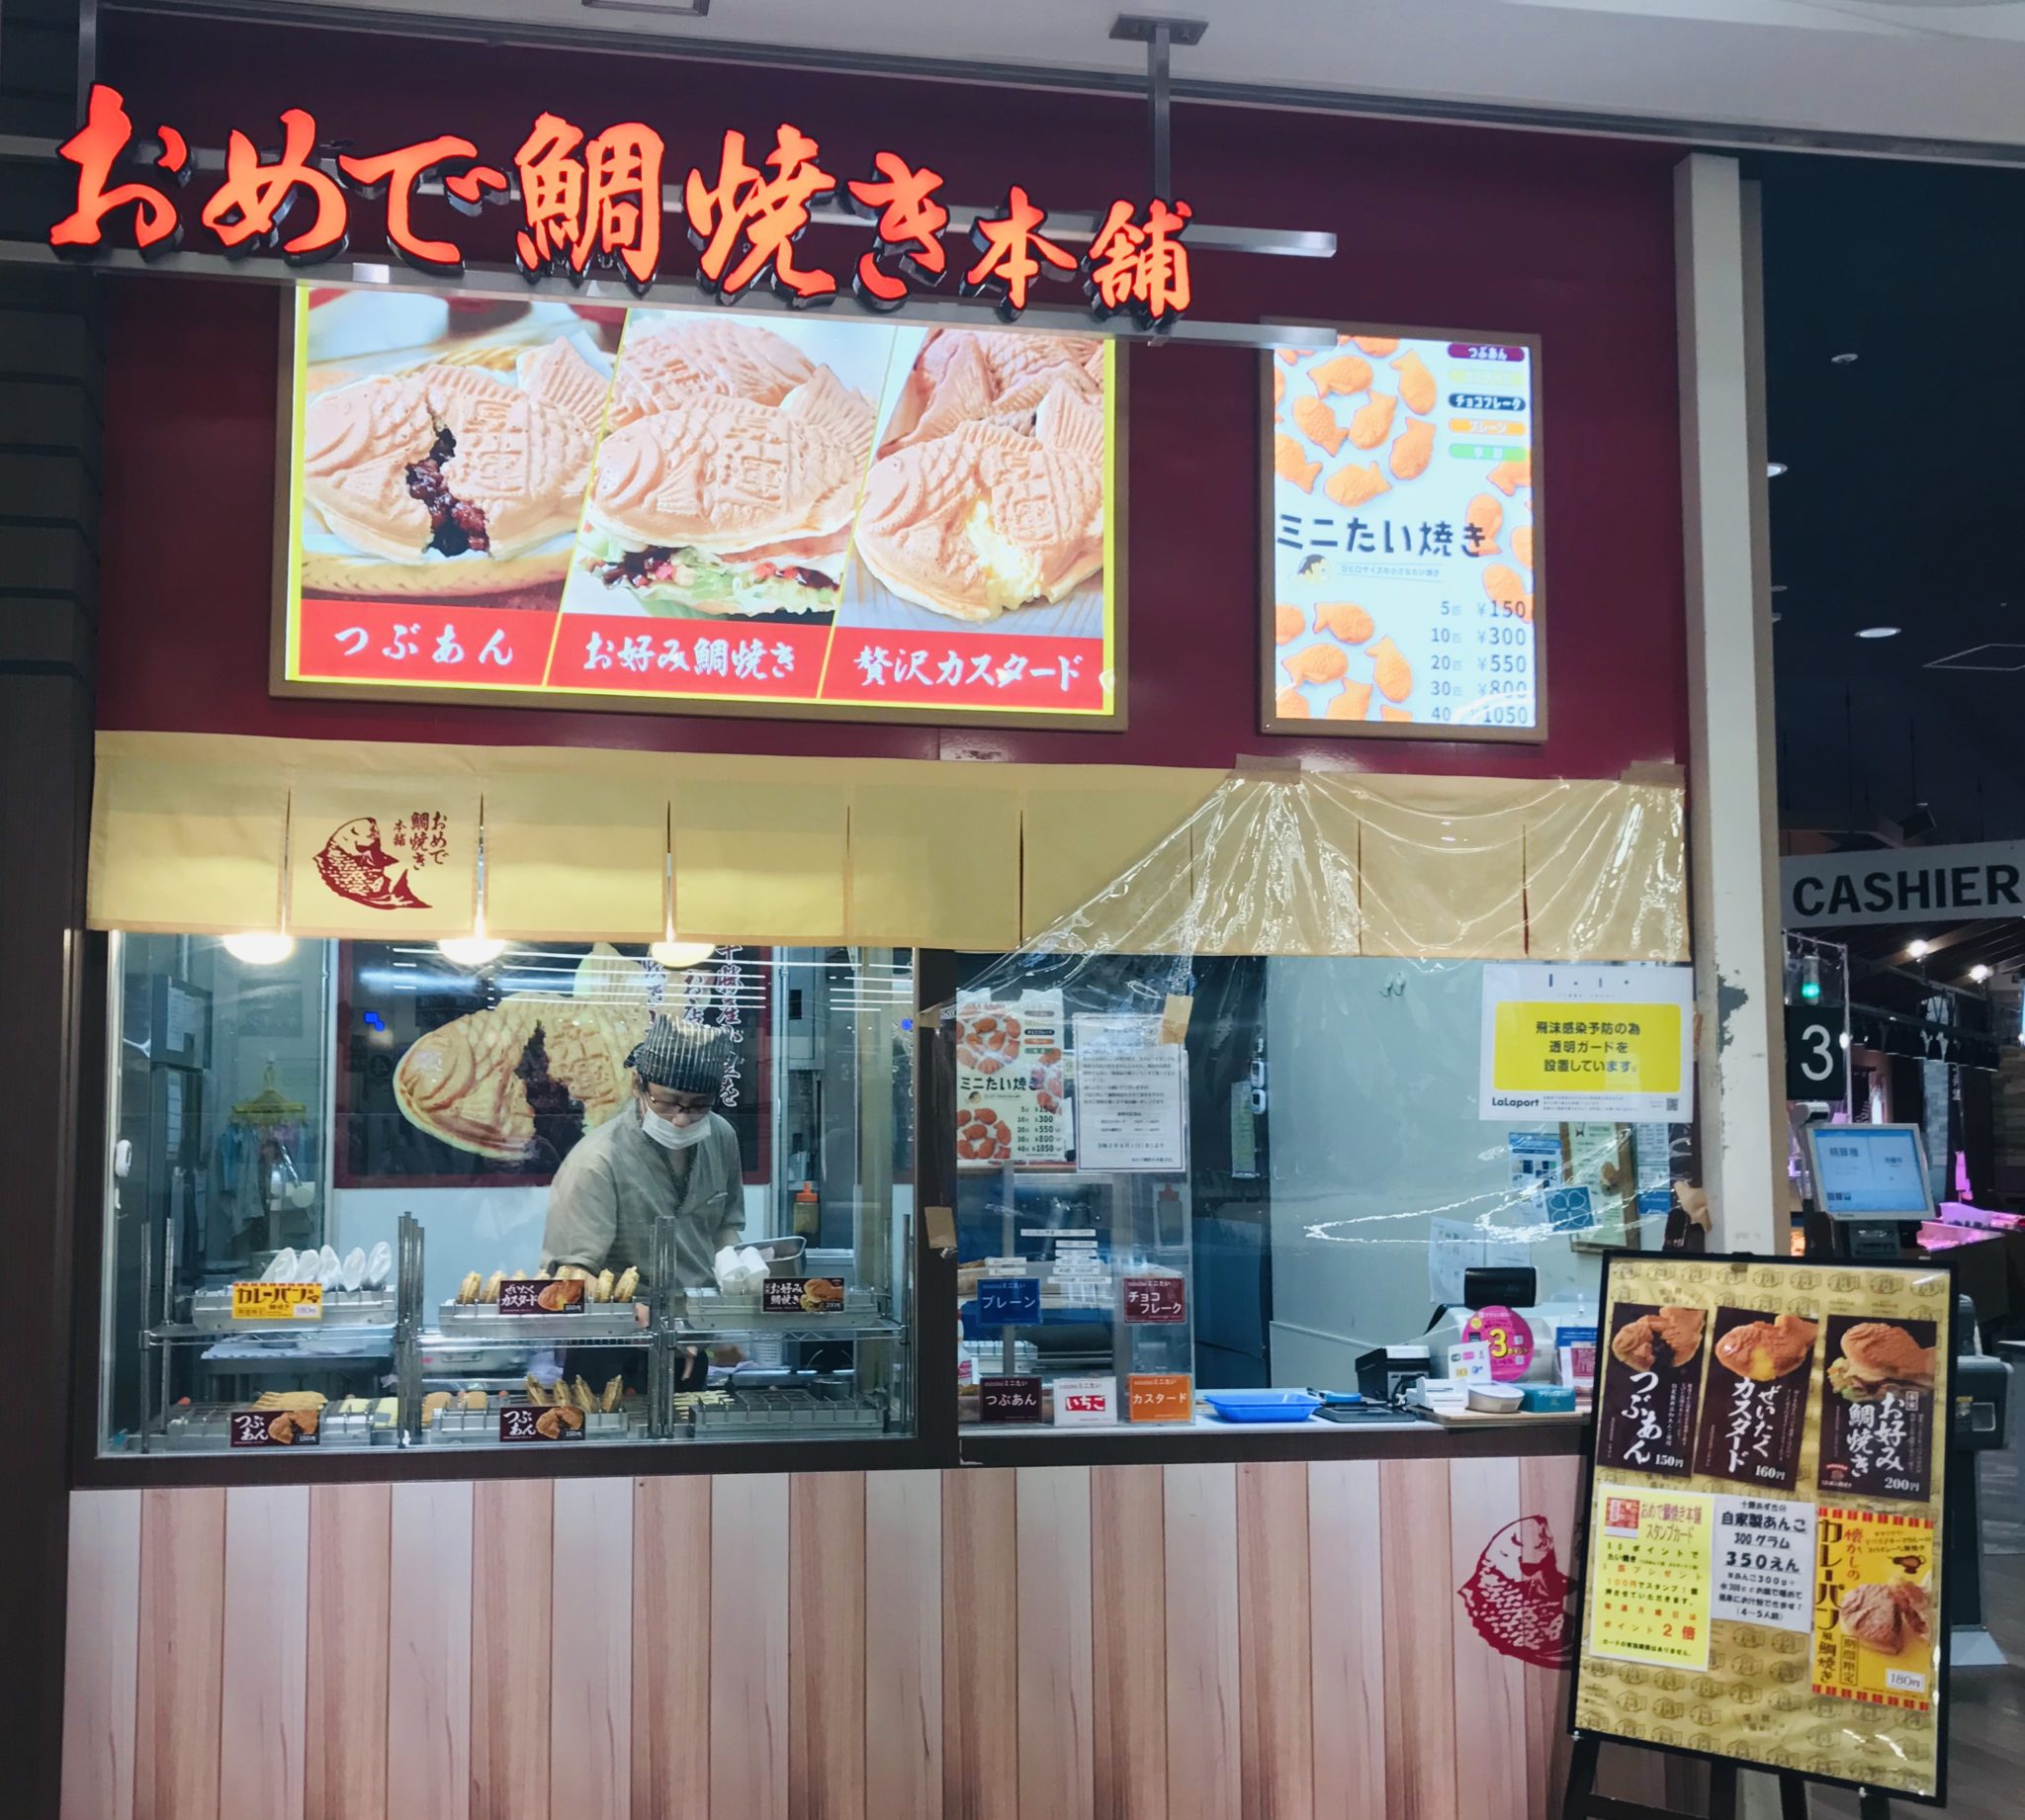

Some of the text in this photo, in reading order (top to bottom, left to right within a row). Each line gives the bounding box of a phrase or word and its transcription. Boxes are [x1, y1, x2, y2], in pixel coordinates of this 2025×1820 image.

[50, 84, 1191, 317] おめで鯛焼き本舗
[1455, 394, 1522, 411] チョコフレーク
[1277, 514, 1486, 559] ミニたい焼き
[334, 624, 513, 665] つぶあん
[583, 632, 796, 680] お好み鯛焼き
[853, 645, 1084, 692] 贅沢カスタード
[409, 812, 430, 871] 鯛焼き
[428, 811, 449, 865] おめで
[1793, 864, 2023, 917] CASHIER
[1536, 1021, 1641, 1036] 飛沫感染予防の為
[1549, 1041, 1629, 1054] 透明ガードを
[1801, 1024, 1834, 1081] 3
[1544, 1059, 1637, 1073] 設置しています。
[960, 1077, 1038, 1091] ミニたい焼き
[1491, 1096, 1540, 1108] LaLaport
[236, 1288, 308, 1304] カレーパン
[770, 1282, 804, 1295] お好み
[1128, 1291, 1161, 1303] チョコ
[501, 1294, 539, 1307] カスタード
[982, 1296, 1036, 1309] プレーン
[1140, 1302, 1182, 1314] フレーク
[985, 1393, 1037, 1407] つぶあん
[1066, 1395, 1105, 1411] いちご
[1132, 1392, 1188, 1404] カスタード
[1622, 1371, 1663, 1465] つぶあん
[1725, 1376, 1756, 1473] カスタード
[1752, 1385, 1783, 1458] ぜいたく
[1846, 1403, 1876, 1477] 鯛焼き
[1874, 1392, 1907, 1471] お好み
[1655, 1454, 1684, 1468] 150円
[1755, 1464, 1786, 1481] 160円
[1885, 1476, 1920, 1492] 200円
[1721, 1511, 1806, 1533] 自家製あんこ
[1725, 1551, 1800, 1572] 350えん
[1844, 1528, 1864, 1581] 懐かしの
[1891, 1673, 1920, 1689] 180円
